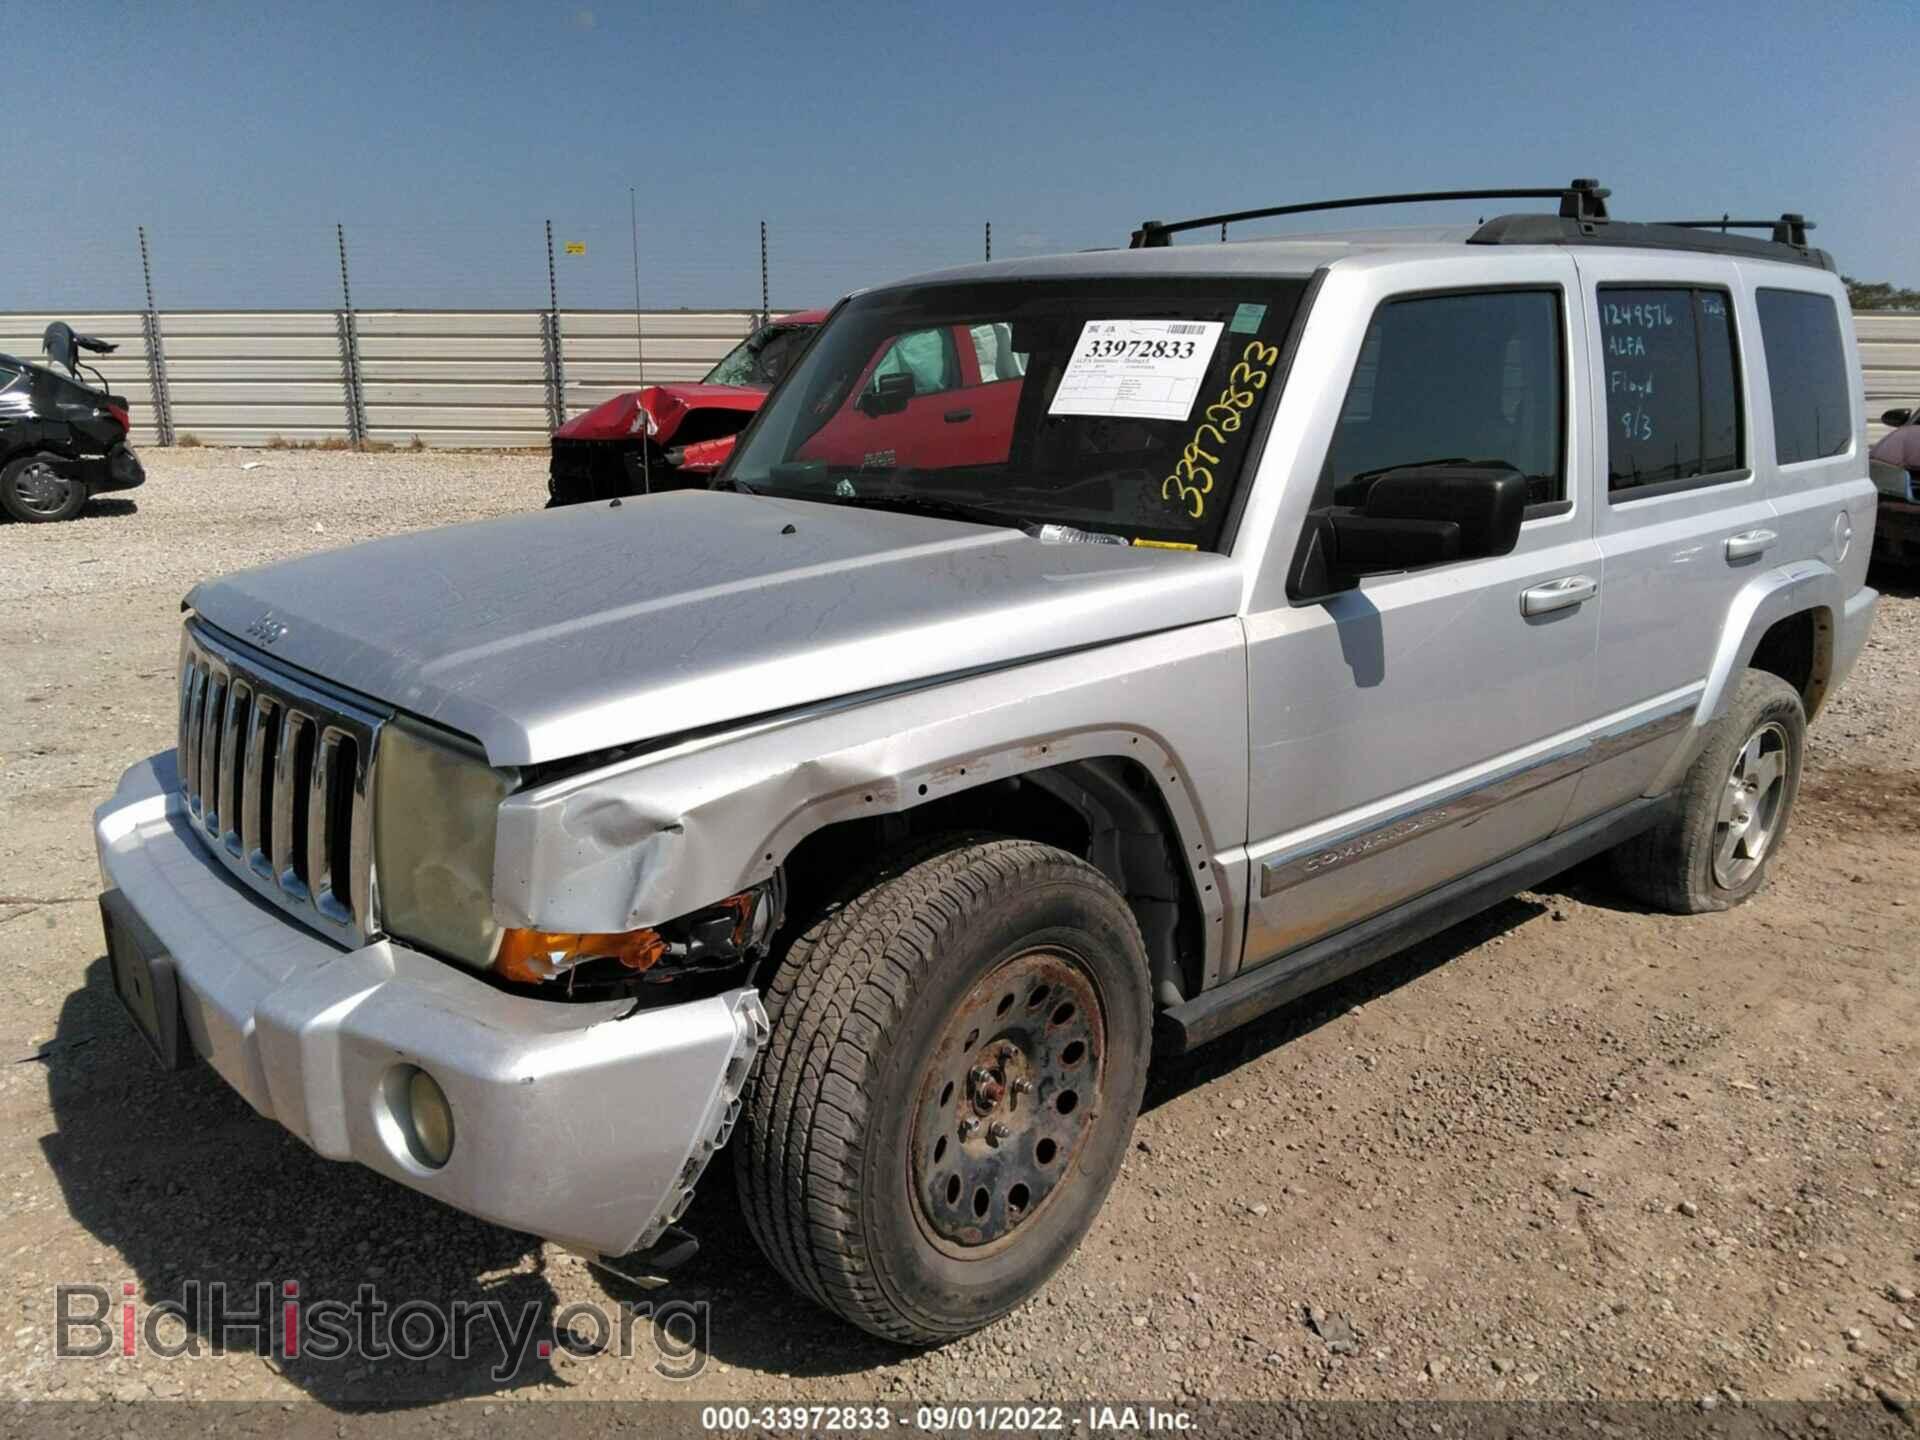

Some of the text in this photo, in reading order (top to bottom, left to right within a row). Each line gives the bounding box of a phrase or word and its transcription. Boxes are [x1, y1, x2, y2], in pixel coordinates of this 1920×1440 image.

[1603, 303, 1673, 329] 1249576
[1085, 340, 1196, 359] 33972833
[1608, 335, 1646, 356] ALFA
[1161, 340, 1279, 518] 33972833
